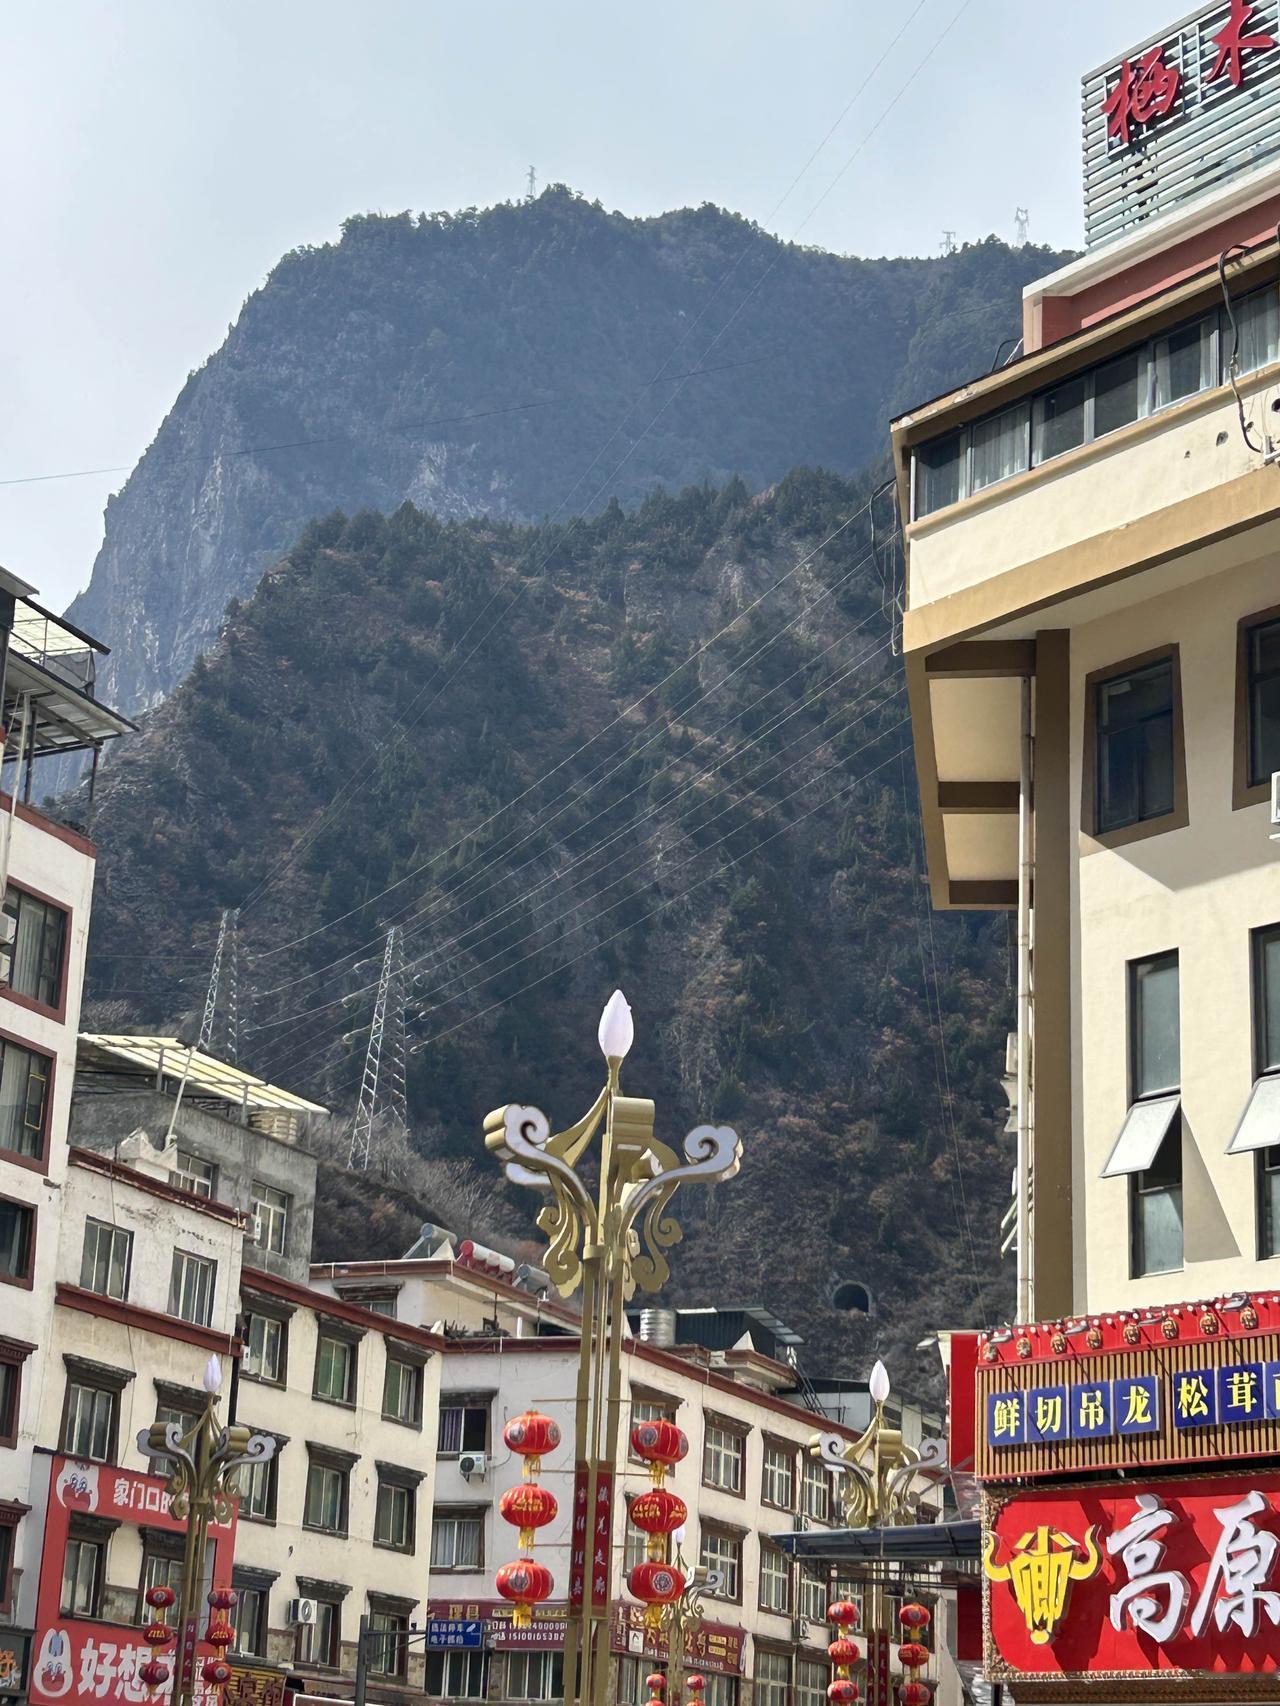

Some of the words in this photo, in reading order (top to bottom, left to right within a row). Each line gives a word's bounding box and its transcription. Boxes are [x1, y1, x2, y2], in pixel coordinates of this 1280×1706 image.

[993, 1385, 1152, 1438] 鲜切吊龙
[1177, 1371, 1280, 1418] 松茸
[1105, 1490, 1280, 1643] 高原
